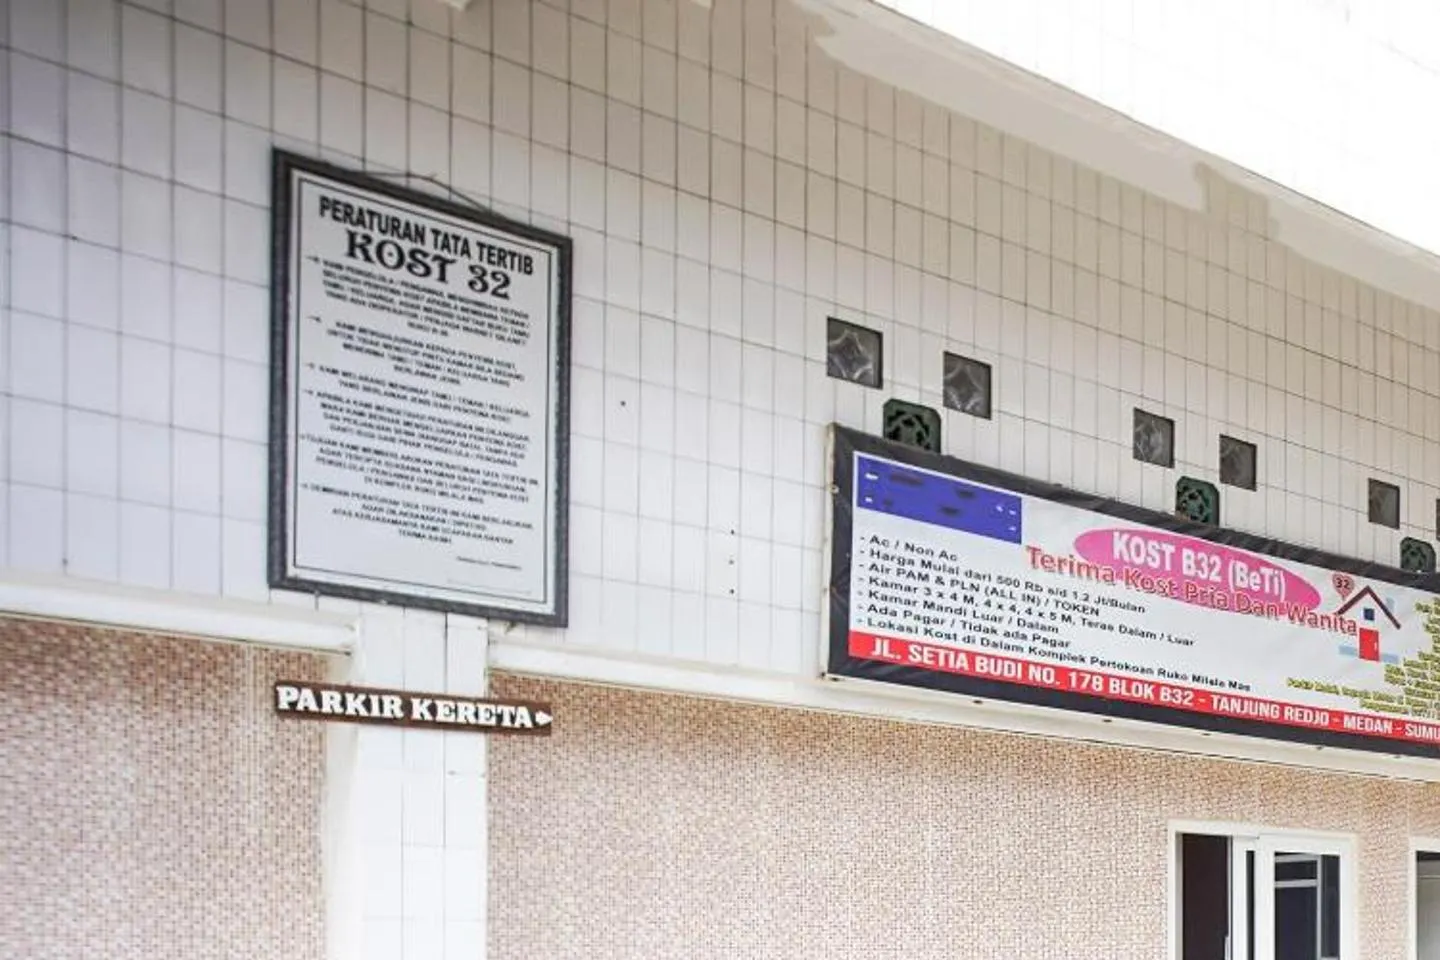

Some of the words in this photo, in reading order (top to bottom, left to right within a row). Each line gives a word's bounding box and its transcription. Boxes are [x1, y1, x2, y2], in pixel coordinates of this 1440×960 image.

[319, 196, 426, 246] PERATURAN
[432, 228, 471, 259] TATA
[476, 242, 534, 276] TERTIB
[345, 230, 455, 284] KOST
[467, 263, 511, 300] 32
[869, 548, 915, 566] Harga
[921, 559, 959, 575] Mulai
[965, 569, 991, 582] dari
[997, 575, 1020, 588] 500
[870, 535, 890, 547] Ac
[905, 542, 934, 557] Non
[939, 550, 957, 561] Ac
[1112, 531, 1176, 571] KOST
[1182, 549, 1222, 582] B32
[1228, 559, 1286, 602] (BeTi)
[869, 563, 891, 574] Air
[896, 568, 929, 582] PAM
[935, 576, 945, 586] &
[950, 579, 980, 592] PLN
[984, 586, 1016, 600] (ALL
[1022, 592, 1040, 606] IN)
[1055, 599, 1099, 616] TOKEN
[869, 576, 918, 593] Kamar
[923, 587, 932, 596] 3
[950, 593, 957, 601] 4
[984, 600, 992, 608] 4
[1025, 607, 1033, 616] 4
[1049, 612, 1057, 620] 5
[1080, 617, 1114, 631] Teras
[1119, 624, 1157, 640] Dalam
[1167, 635, 1194, 646] Luar
[869, 590, 918, 606] Kamar
[923, 600, 967, 616] Mandi
[973, 610, 1004, 622] Luar
[1017, 618, 1059, 633] Dalam
[1025, 544, 1116, 585] Terima
[1123, 567, 1177, 598] Kost
[1185, 582, 1229, 611] Pria
[1235, 591, 1279, 620] Dan
[1286, 602, 1358, 635] Wanita
[1335, 578, 1350, 589] 32
[867, 604, 898, 617] Ada
[903, 610, 945, 627] Pagar
[960, 620, 999, 636] Tidak
[1003, 629, 1028, 641] ada
[1032, 634, 1072, 649] Pagar
[867, 618, 919, 634] Lokasi
[924, 627, 957, 641] Kost
[962, 634, 976, 645] di
[981, 636, 1024, 653] Dalam
[1028, 645, 1086, 663] Komplek
[1090, 656, 1154, 675] Pertokoan
[1157, 667, 1189, 680] Ruko
[275, 685, 404, 719] PARKIR
[408, 697, 534, 728] KERETA
[871, 637, 902, 659] JL.
[908, 644, 969, 671] SETIA
[975, 655, 1022, 679] BUDI
[1028, 666, 1060, 686] NO.
[1067, 672, 1103, 691] 178
[1108, 678, 1155, 701] BLOK
[1159, 687, 1194, 706] B32
[1211, 694, 1280, 719] TANJUNG
[1284, 706, 1330, 727] REDJO
[1343, 714, 1393, 735] MEDAN
